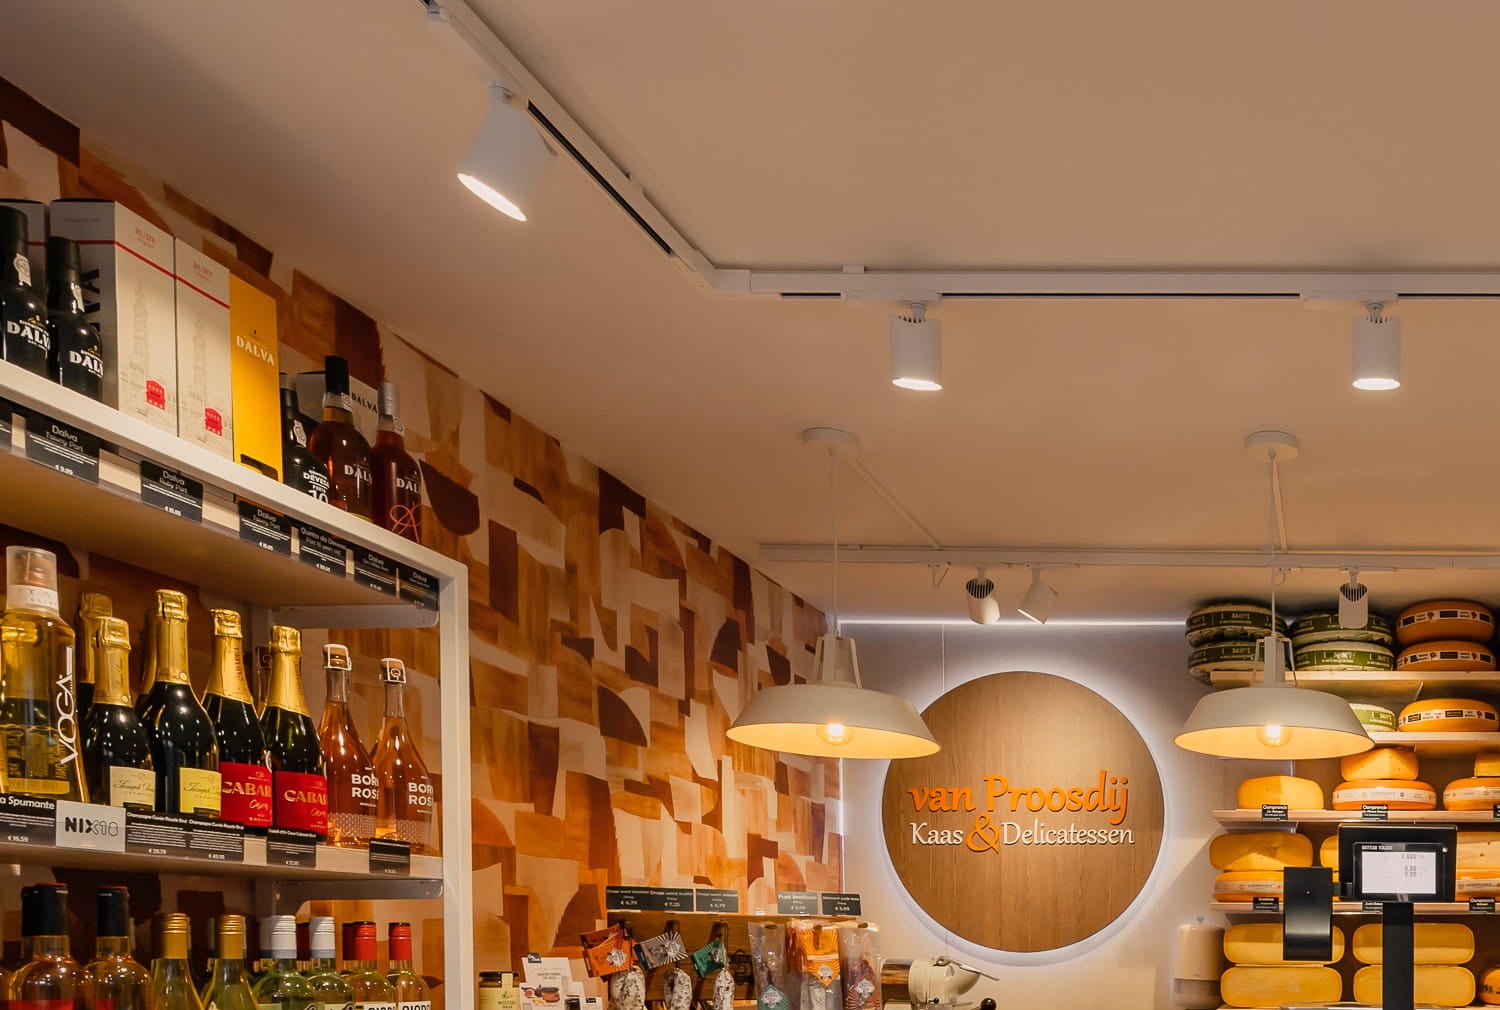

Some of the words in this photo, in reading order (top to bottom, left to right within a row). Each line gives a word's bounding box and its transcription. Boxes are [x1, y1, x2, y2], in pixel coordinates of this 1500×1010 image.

[6, 320, 51, 350] DALV
[235, 335, 276, 367] DALVA
[351, 392, 378, 414] DALVA
[8, 795, 55, 811] Spumante
[907, 785, 977, 813] van
[982, 769, 1130, 826] Proosdij
[909, 821, 964, 846] Kaas
[965, 813, 1000, 855] &
[1001, 818, 1135, 846] Delicatessen
